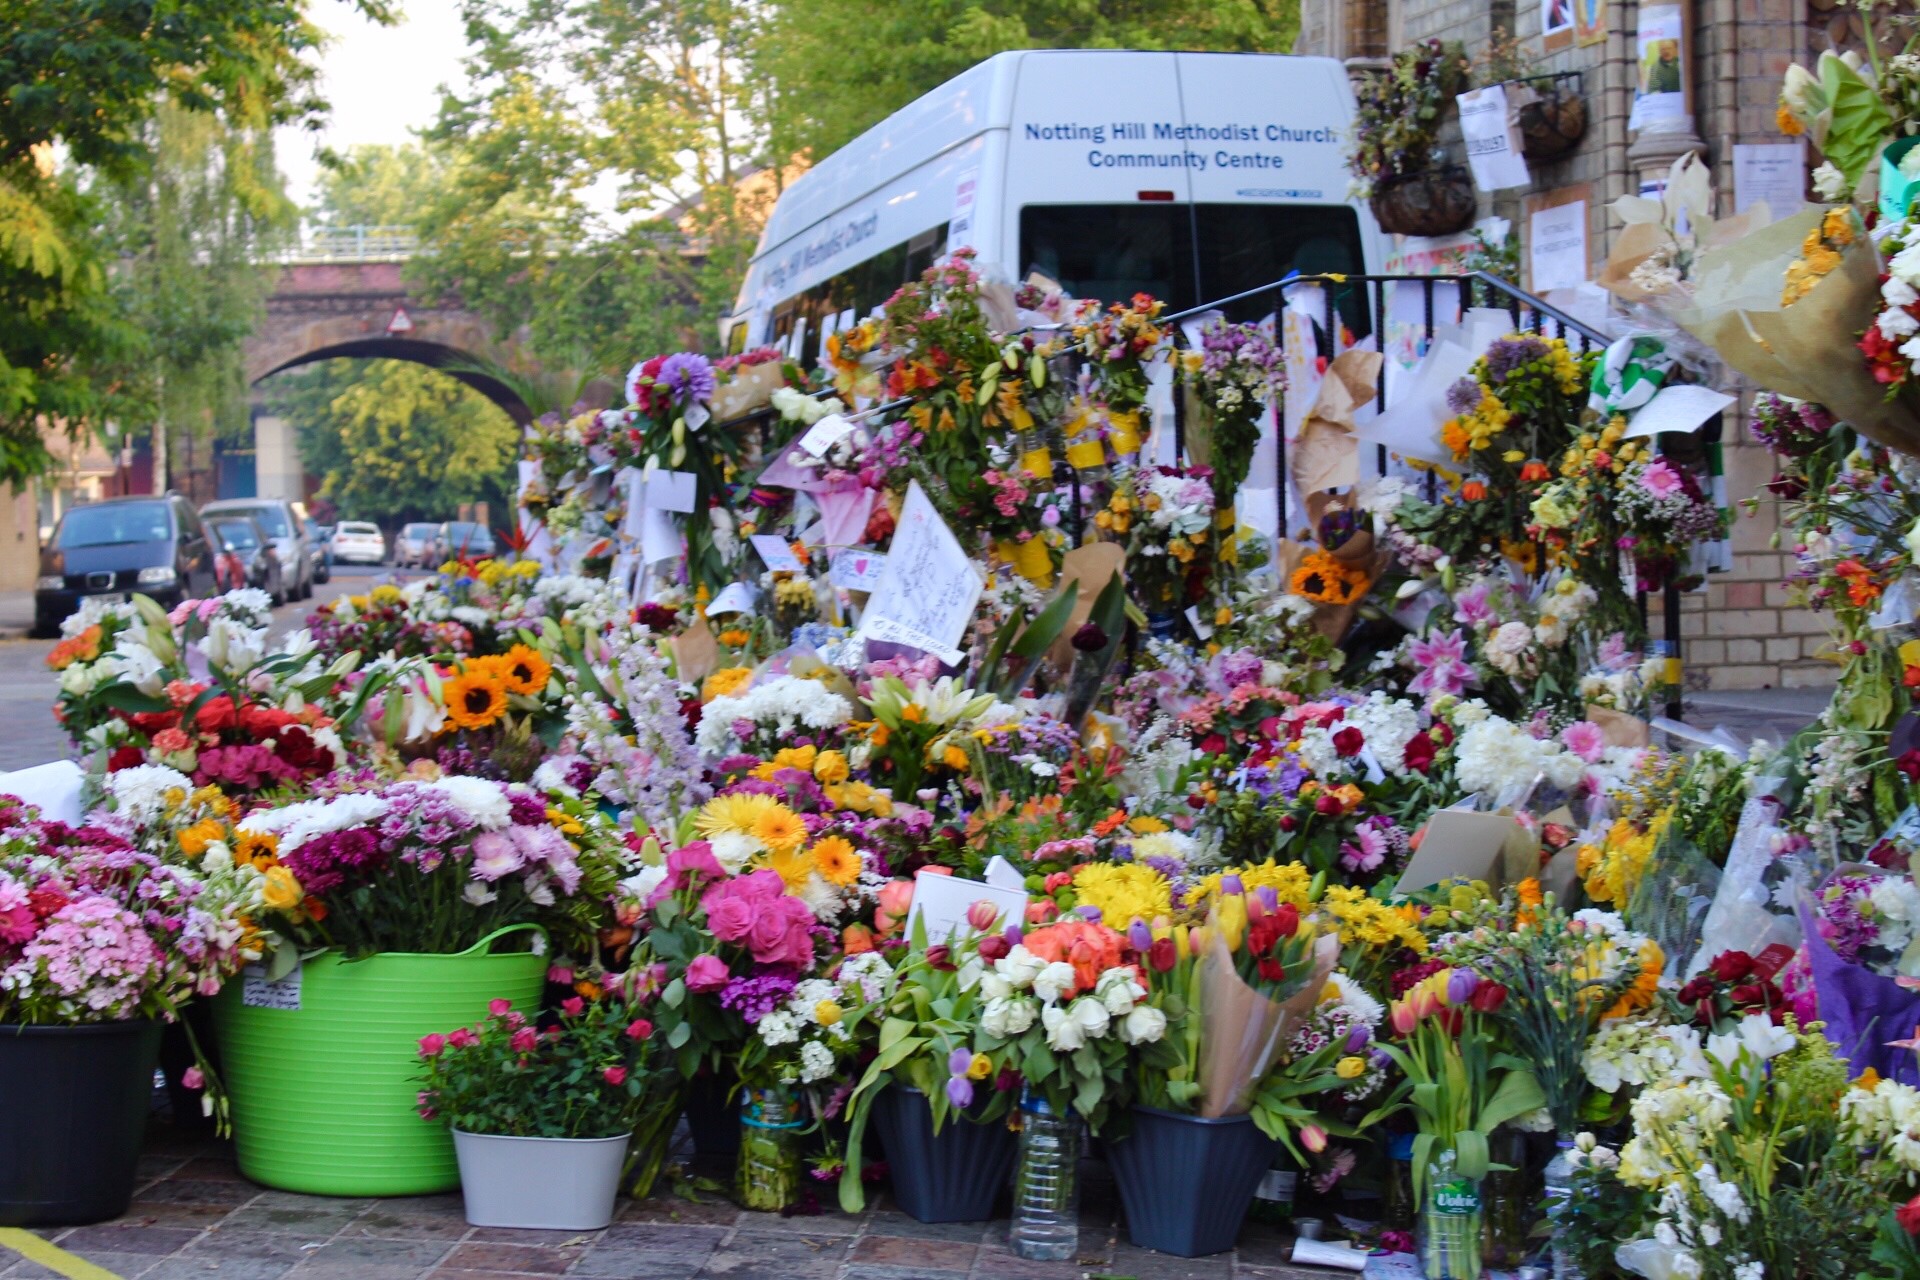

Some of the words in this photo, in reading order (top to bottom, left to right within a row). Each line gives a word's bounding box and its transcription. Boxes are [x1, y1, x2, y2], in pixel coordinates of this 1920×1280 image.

[1025, 122, 1106, 143] Notting
[1111, 122, 1145, 139] Hill
[1152, 122, 1260, 141] Methodist
[1087, 150, 1207, 171] Community
[1215, 151, 1284, 168] Centre
